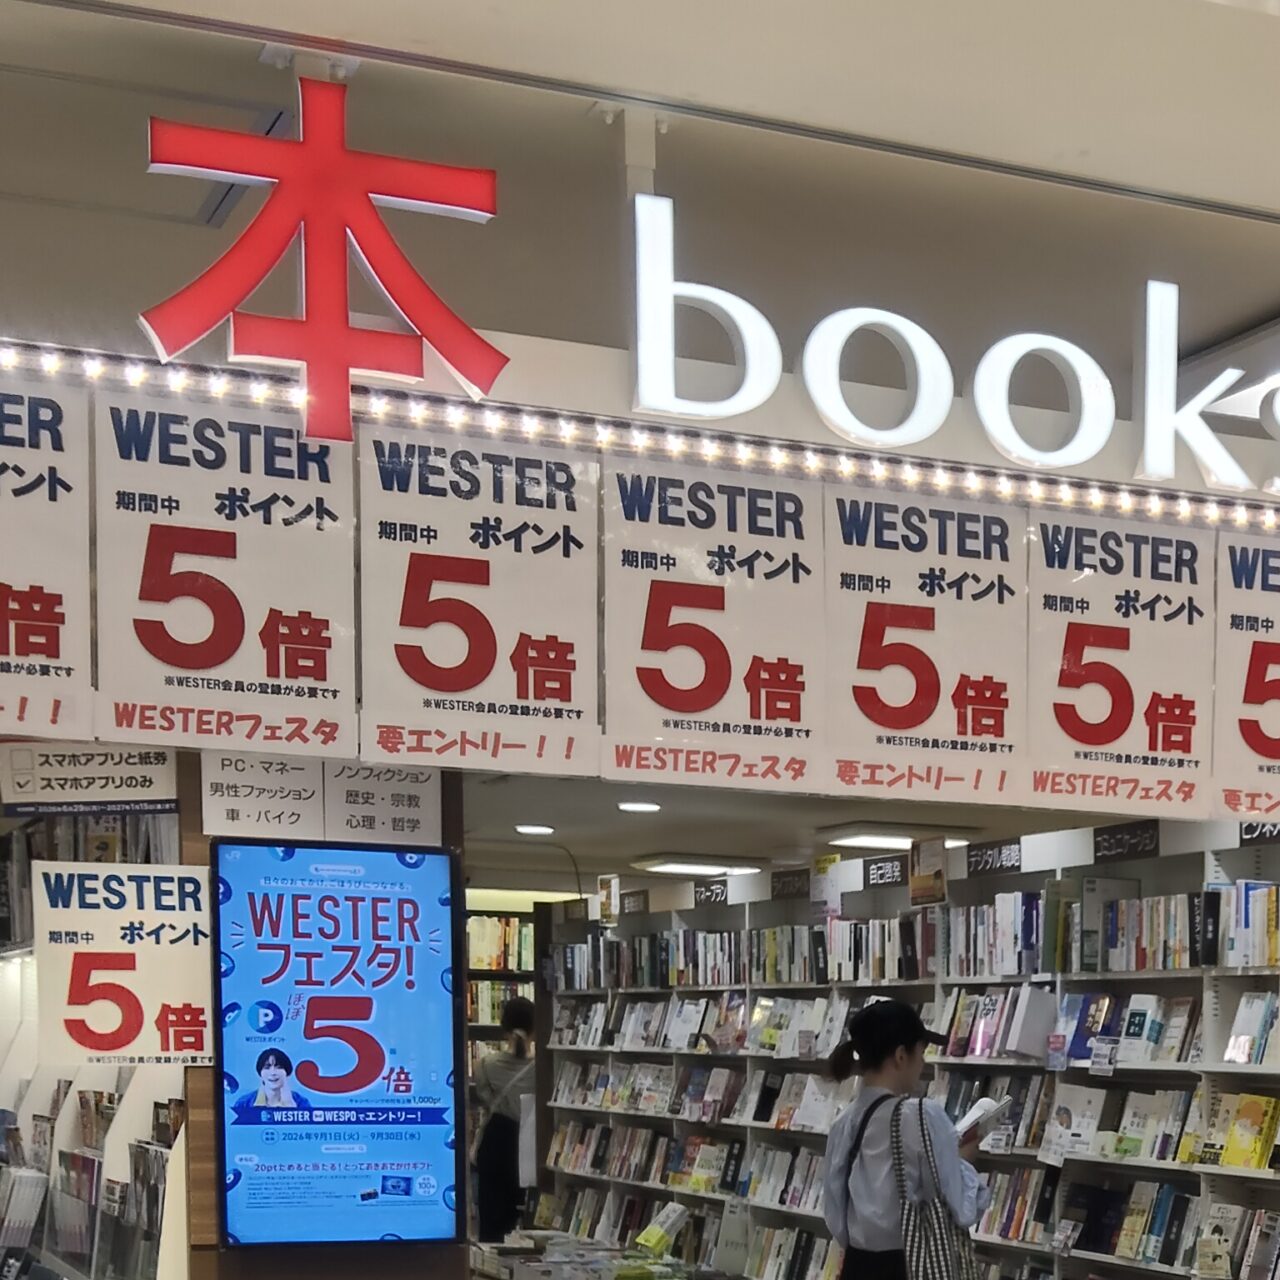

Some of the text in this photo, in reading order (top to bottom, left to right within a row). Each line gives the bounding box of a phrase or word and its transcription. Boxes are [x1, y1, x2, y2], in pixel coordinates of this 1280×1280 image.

[138, 77, 511, 441] 本
[110, 407, 331, 483] WESTER
[372, 439, 578, 512] WESTER
[115, 487, 339, 531] 期間中 ポイント
[616, 472, 805, 541] WESTER
[378, 516, 585, 558] 期間中 ポイント
[836, 497, 1011, 563] WESTER
[621, 544, 812, 584] 期間中 ポイント
[1040, 523, 1198, 585] WESTER
[839, 567, 1017, 605] 期間中 ポイント
[1043, 590, 1204, 625] 期間中 ポイント
[1230, 614, 1275, 634] 期間中
[114, 702, 340, 746] WESTERフェスタ
[38, 751, 168, 768] スマホアプリと紙券
[221, 758, 305, 774] PC・マネー
[333, 764, 432, 784] ノンフィクション
[614, 744, 808, 781] WESTERフェスタ
[40, 775, 154, 790] スマホアプリのみ
[210, 782, 315, 801] 男性ファッション
[345, 789, 421, 810] 歴史・宗教
[1033, 770, 1196, 802] WESTERフェスタ
[225, 808, 301, 826] 車・バイク
[345, 815, 421, 833] 心理・哲学
[870, 861, 901, 884] 自己啓発
[968, 843, 1020, 871] デジタル戦略
[42, 871, 202, 912] WESTER
[48, 921, 211, 946] 期間中 ポイント
[247, 892, 420, 942] WESTER
[257, 944, 415, 989] フェスタ!
[273, 1111, 310, 1122] WESTER
